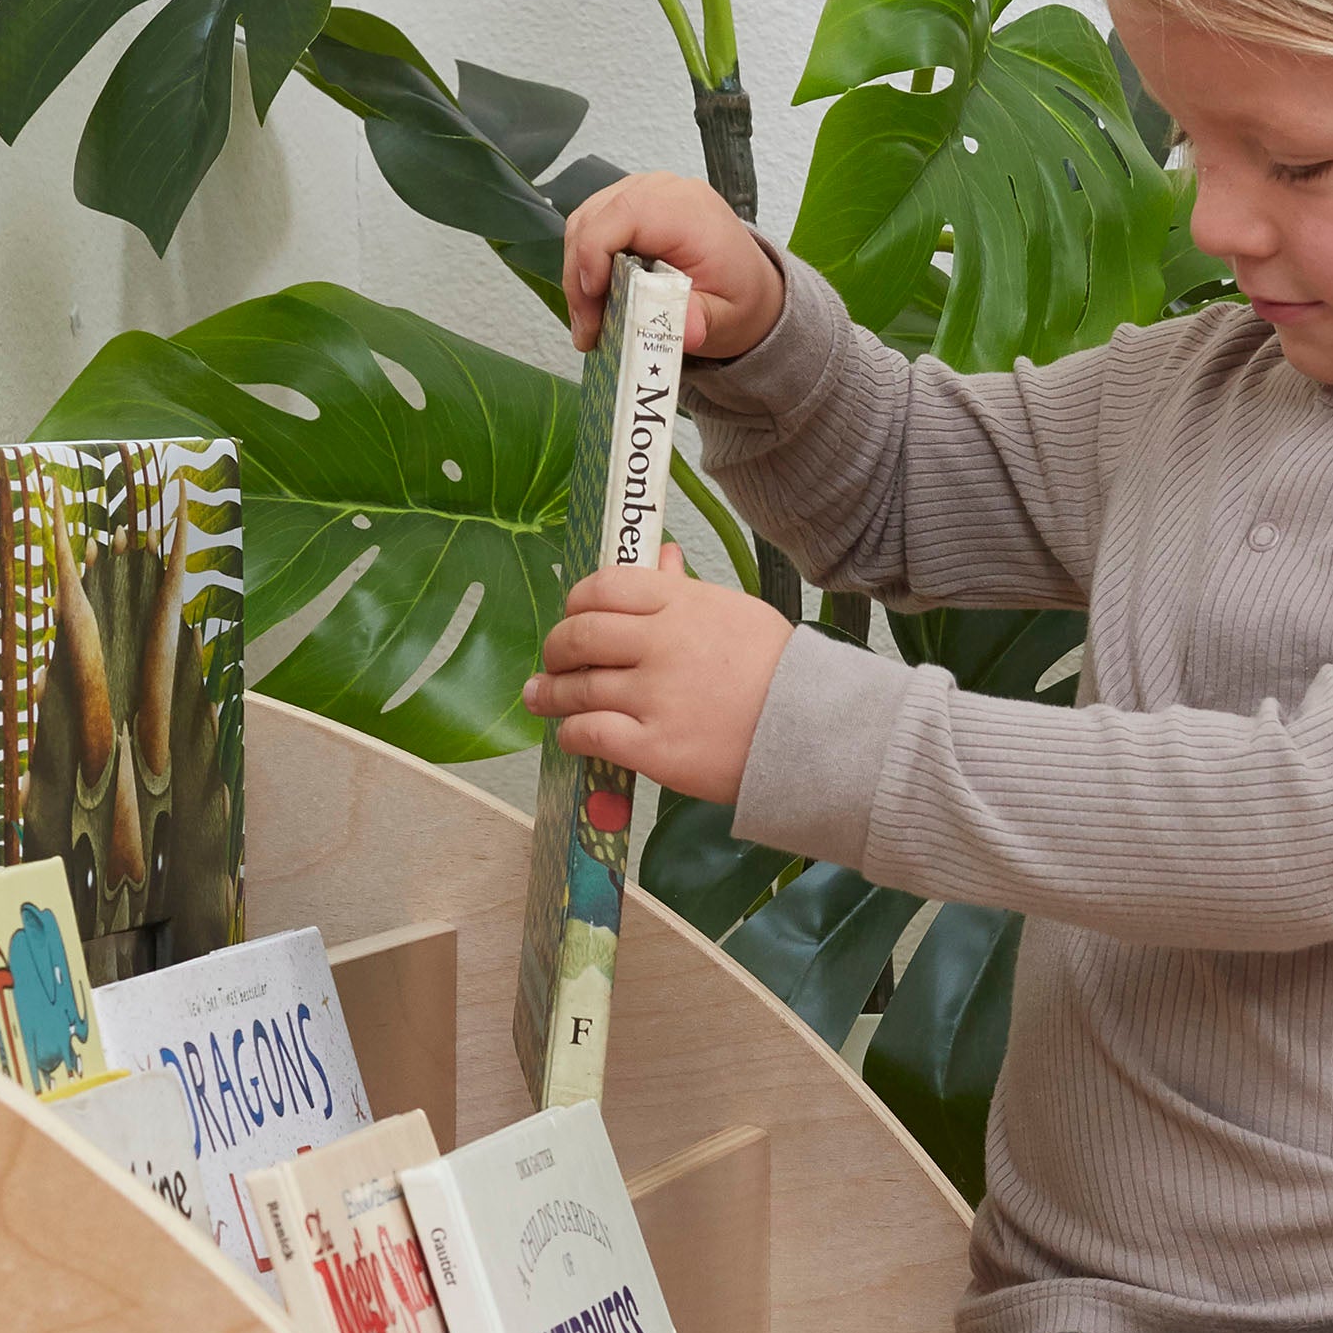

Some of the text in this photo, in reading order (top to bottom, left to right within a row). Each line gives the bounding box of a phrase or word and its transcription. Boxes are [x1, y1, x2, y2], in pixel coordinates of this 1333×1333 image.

[637, 328, 683, 342] Houghton
[570, 1016, 593, 1045] F
[159, 1003, 333, 1160] DRAGONS
[431, 1228, 457, 1286] Gautier
